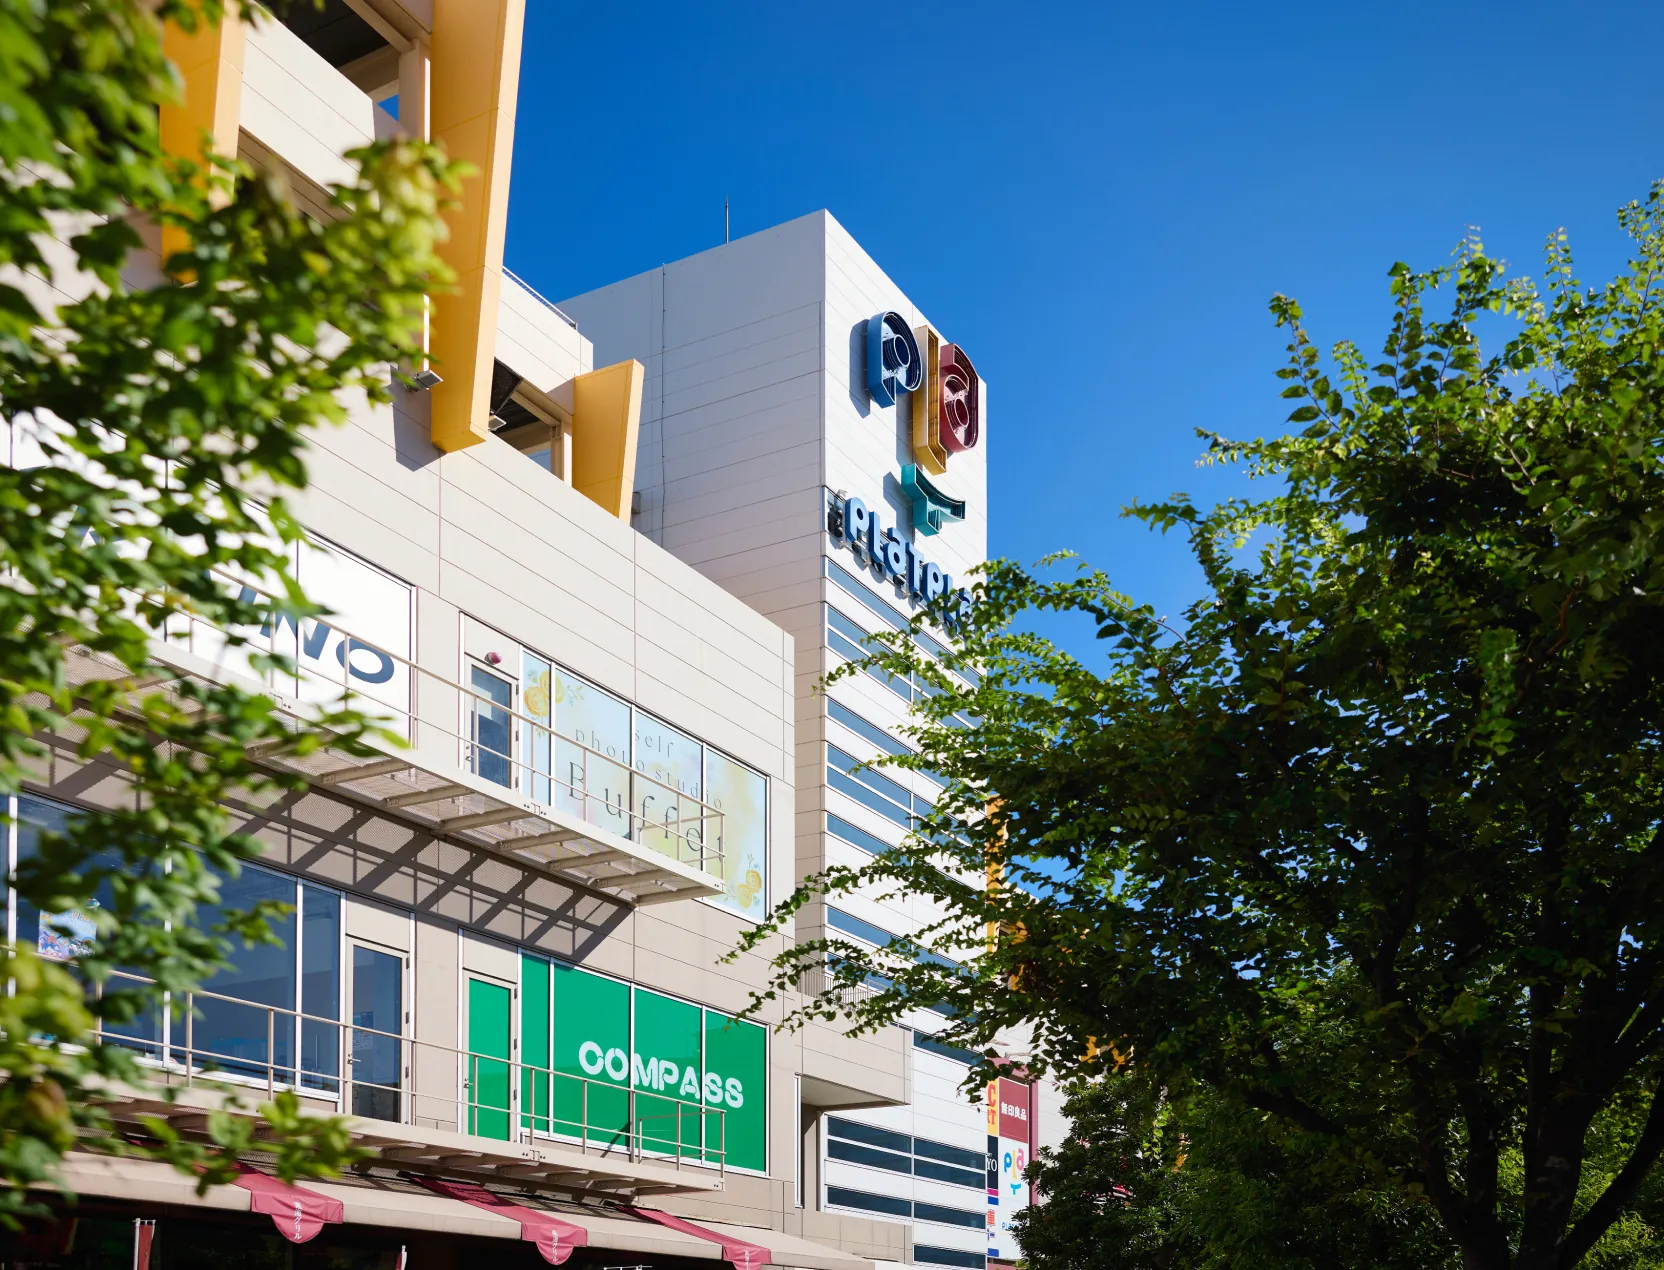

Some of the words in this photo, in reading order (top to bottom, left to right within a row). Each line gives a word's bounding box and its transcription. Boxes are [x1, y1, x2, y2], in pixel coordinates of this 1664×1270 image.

[634, 730, 673, 757] self
[655, 769, 722, 809] studio
[579, 1041, 744, 1108] COMPASS
[1001, 1101, 1027, 1121] 無印良品
